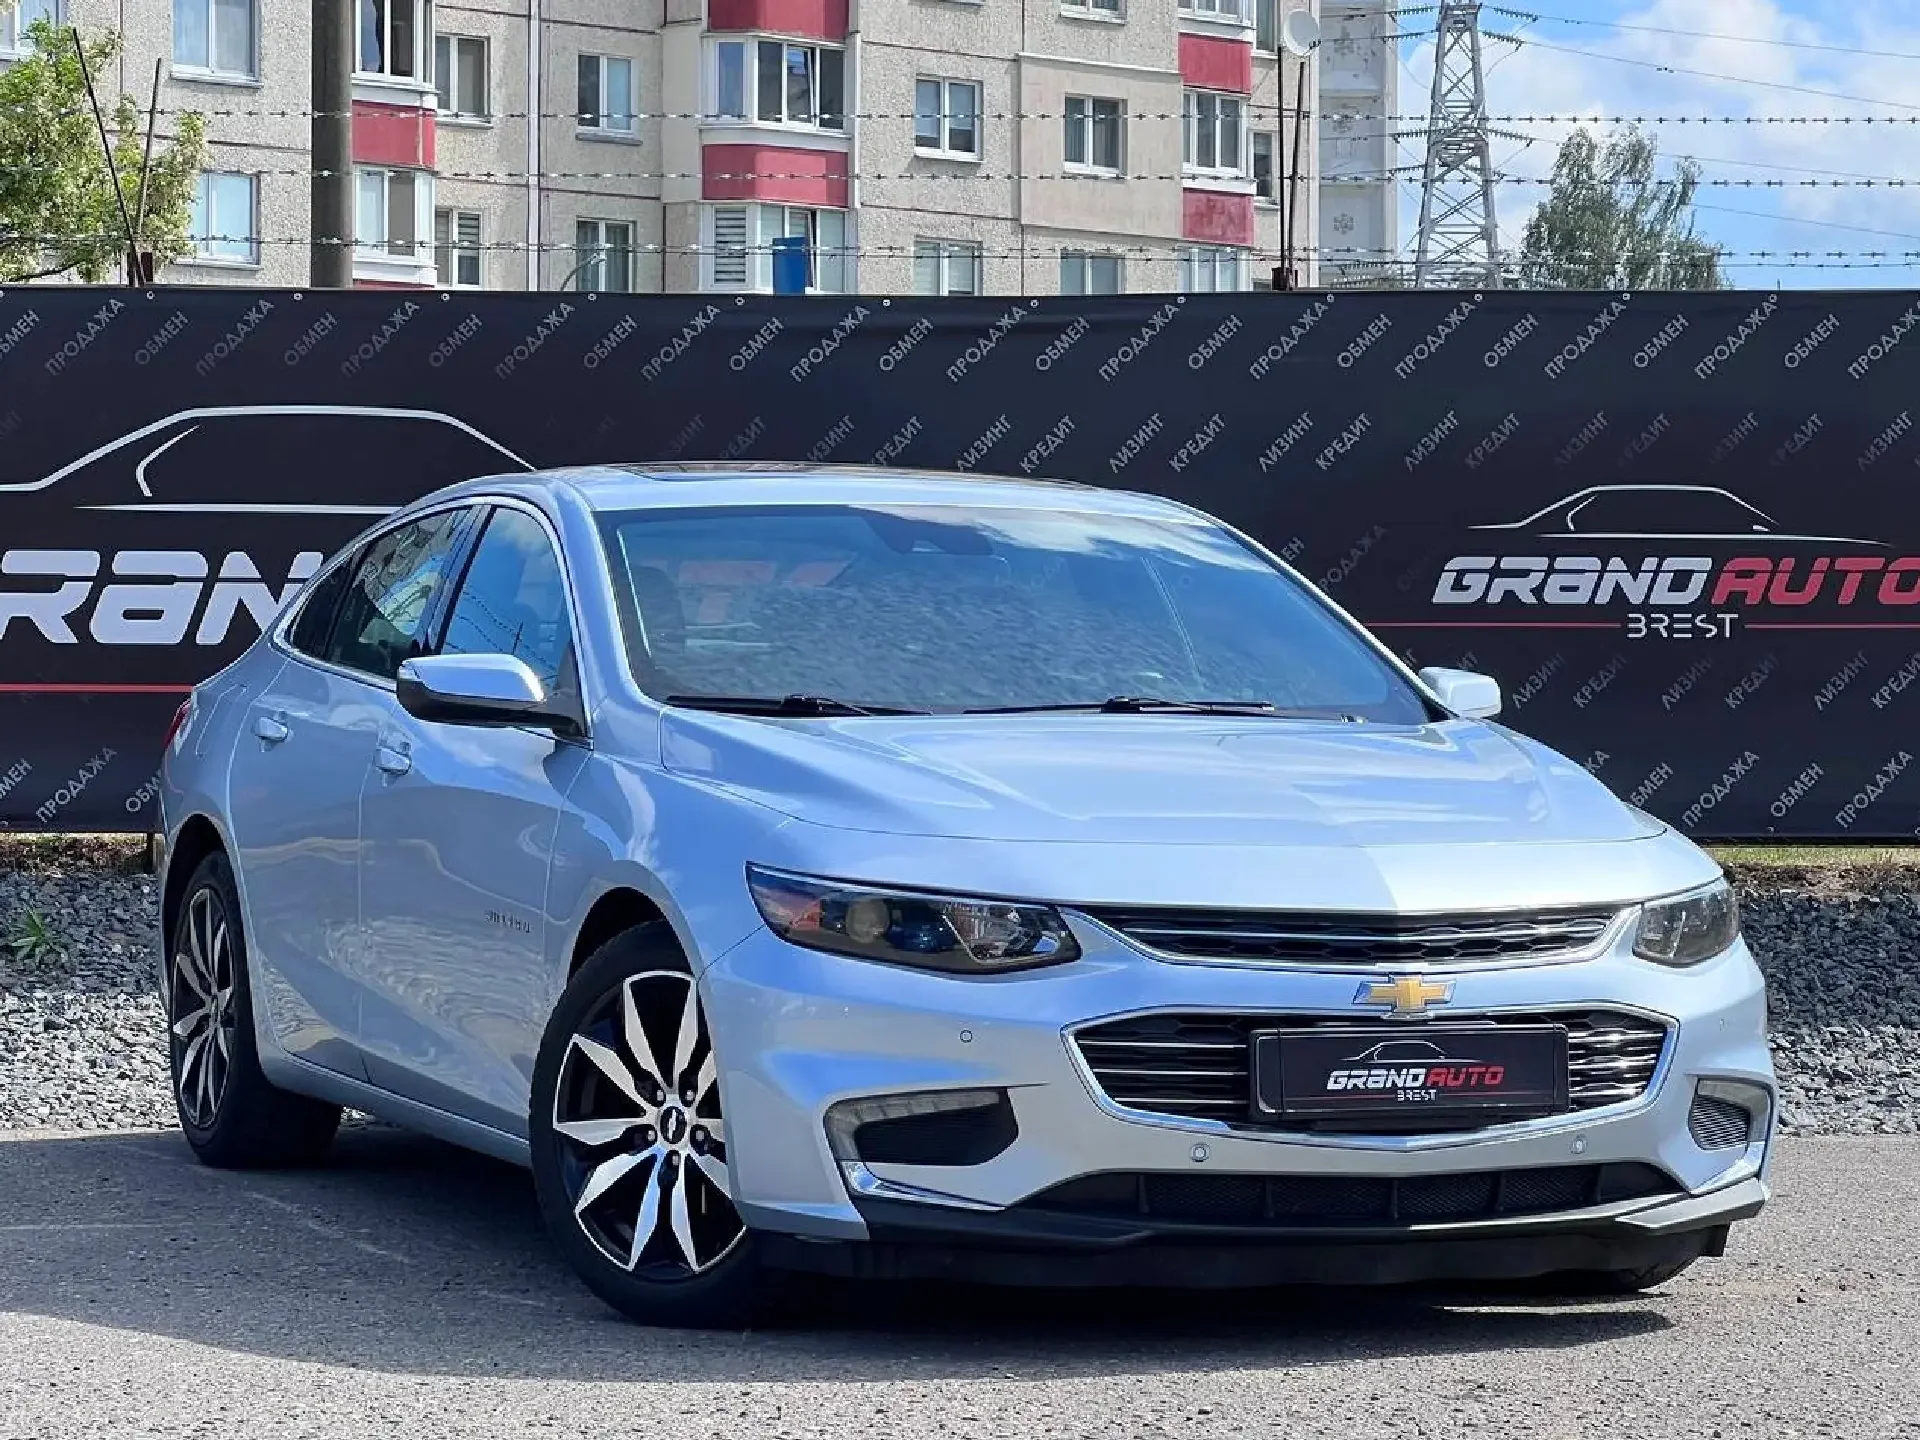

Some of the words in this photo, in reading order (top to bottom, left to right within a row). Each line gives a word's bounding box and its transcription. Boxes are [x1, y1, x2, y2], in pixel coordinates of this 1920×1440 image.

[0, 309, 40, 359] БМЕН
[45, 299, 125, 376] ПРОДАЖА
[134, 311, 189, 365] ОБМЕН
[196, 299, 275, 376] ПРОДАЖА
[284, 312, 338, 366] ОБМЕН
[340, 300, 421, 377] ПРОДАЖА
[428, 313, 484, 367] ОБМЕН
[496, 302, 576, 379] ПРОДАЖА
[583, 314, 640, 369] ОБМЕН
[640, 304, 721, 382] ПРОДАЖА
[730, 317, 785, 371] ОБМЕН
[790, 305, 871, 383] ПРОДАЖА
[879, 317, 934, 372] ОБМЕН
[946, 305, 1028, 383] ПРОДАЖА
[1035, 316, 1091, 372] ОБМЕН
[1098, 302, 1180, 382] ПРОДАЖА
[1188, 314, 1243, 370] ОБМЕН
[1250, 302, 1329, 380] ПРОДАЖА
[1337, 313, 1392, 368] ОБМЕН
[1394, 301, 1476, 379] ПРОДАЖА
[1484, 312, 1539, 368] ОБМЕН
[1544, 301, 1627, 379] ПРОДАЖА
[1634, 313, 1690, 368] ОБМЕН
[1694, 301, 1777, 379] ПРОДАЖА
[1784, 313, 1841, 368] ОБМЕН
[1848, 302, 1920, 379] ПРОДАЖ
[806, 414, 855, 461] ИЗИНГ
[957, 413, 1011, 472] ЛИЗИНГ
[1019, 414, 1077, 474] КРЕДИТ
[1108, 412, 1166, 474] ЛИЗИНГ
[1169, 413, 1227, 473] КРЕДИТ
[1258, 410, 1315, 473] ЛИЗИНГ
[1315, 412, 1372, 471] КРЕДИТ
[1404, 410, 1460, 472] ЛИЗИНГ
[1464, 413, 1521, 470] КРЕДИТ
[1856, 410, 1912, 472] ЛИЗИНГ
[1626, 613, 1739, 639] BREST
[1813, 651, 1868, 711] ЛИЗИНГ
[36, 748, 117, 822] ПРОДАЖА
[125, 768, 162, 812] ОБМ
[1629, 761, 1674, 808] БМЕН
[1681, 751, 1760, 828] ПРОДАЖА
[1770, 762, 1824, 817] ОБМЕН
[1835, 750, 1914, 828] ПРОДАЖА
[1396, 1089, 1437, 1102] BREST
